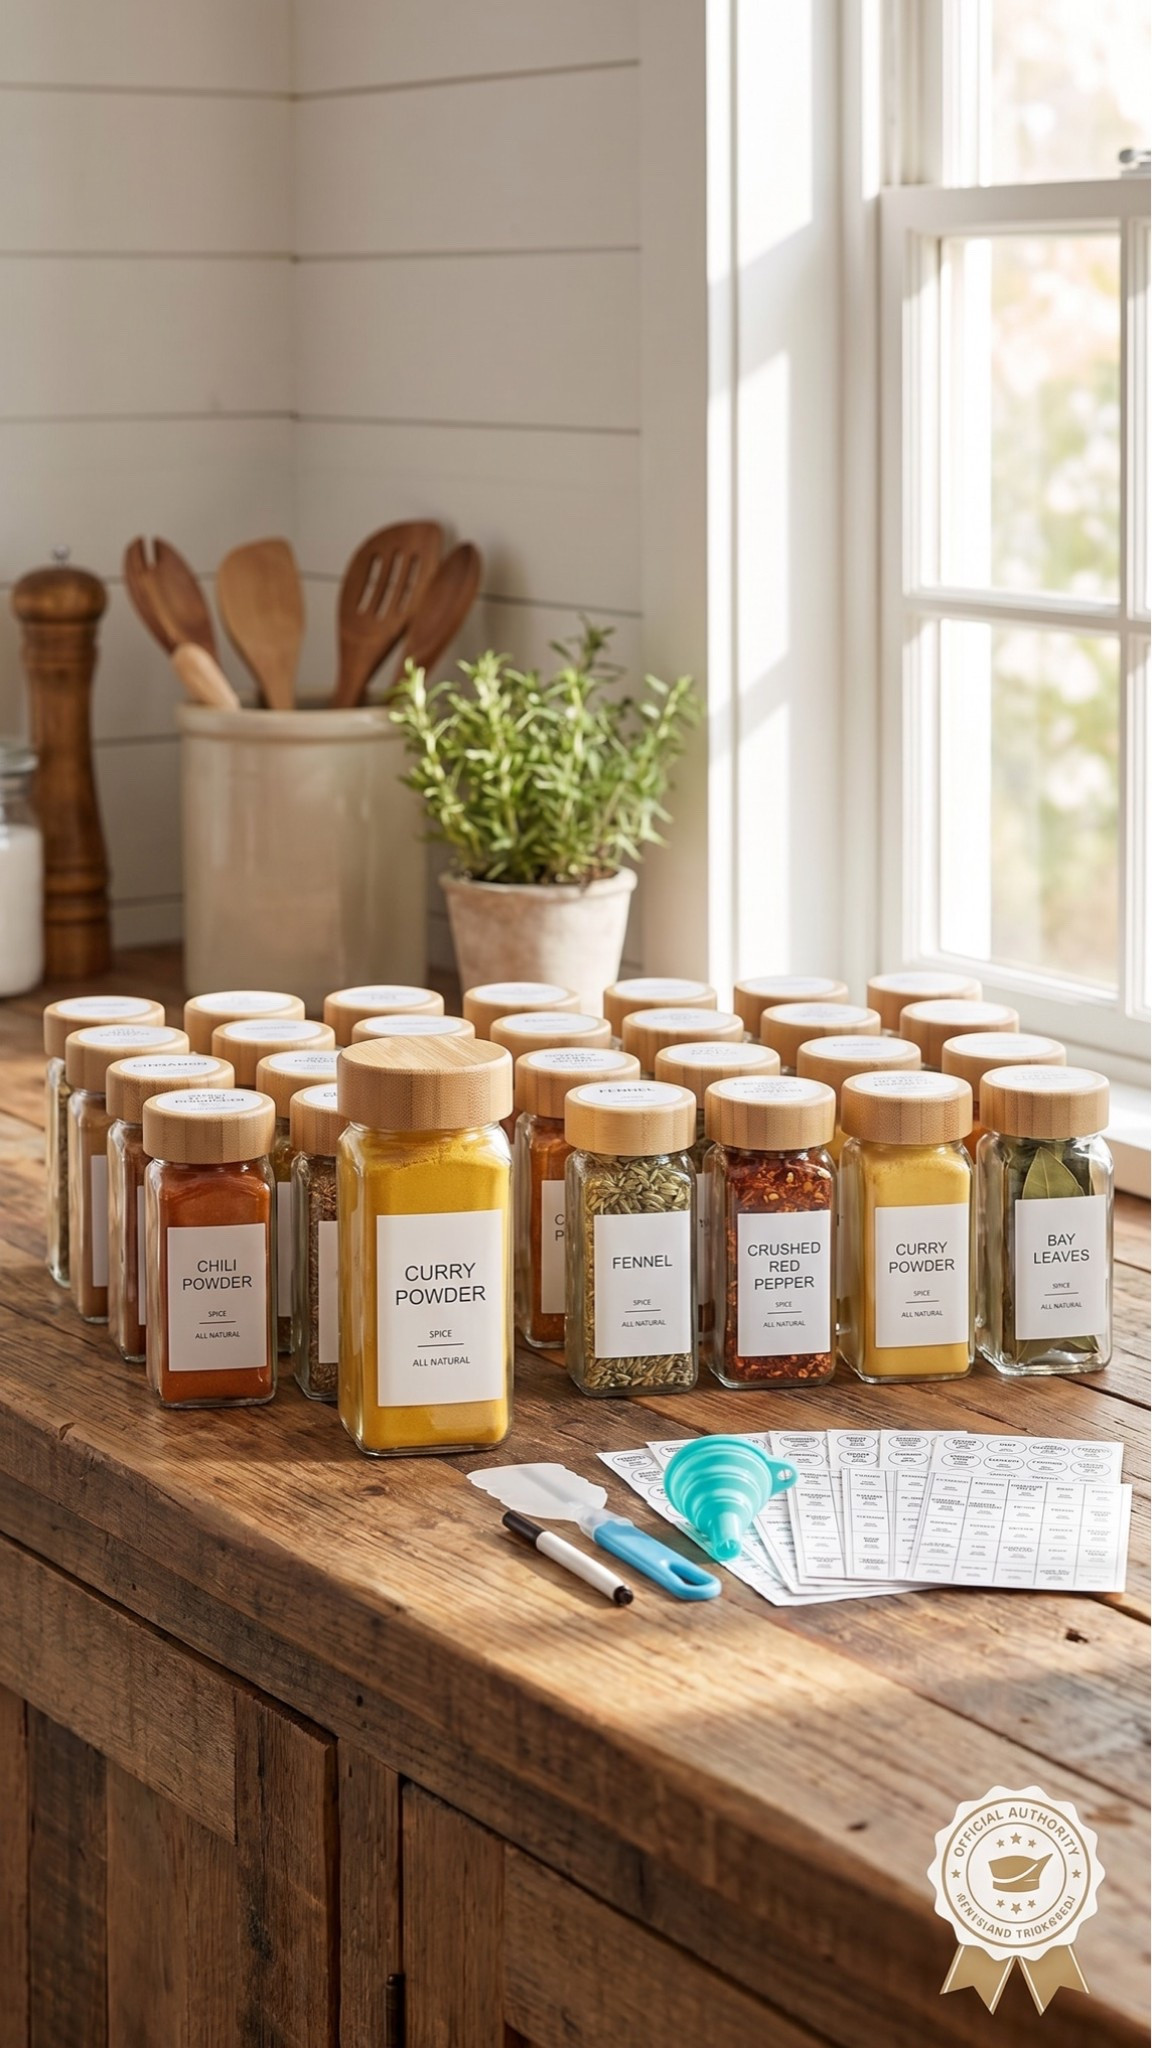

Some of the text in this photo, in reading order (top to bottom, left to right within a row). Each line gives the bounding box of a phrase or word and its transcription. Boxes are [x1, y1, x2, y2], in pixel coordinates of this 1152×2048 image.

[1047, 1232, 1076, 1247] BAY
[747, 1241, 822, 1257] CRUSHED
[895, 1240, 948, 1257] CURRY
[612, 1254, 673, 1270] FENNEL
[1033, 1248, 1090, 1265] LEAVES
[197, 1258, 237, 1273] CHILI
[404, 1262, 477, 1282] CURRY
[769, 1259, 801, 1273] RED
[888, 1258, 955, 1274] POWDER
[182, 1275, 253, 1291] POWDER
[754, 1275, 815, 1291] PEPPER
[395, 1285, 487, 1306] POWDER
[913, 1289, 931, 1297] SPICE
[632, 1298, 652, 1306] SPICE
[1053, 1301, 1083, 1309] NATURAL
[207, 1310, 227, 1318] SPICE
[914, 1309, 944, 1317] NATURAL
[634, 1319, 667, 1327] NATURAL
[775, 1319, 806, 1328] NATURAL
[208, 1330, 241, 1339] NATURAL
[429, 1329, 453, 1339] SPICE
[412, 1356, 471, 1367] ALL NATURAL
